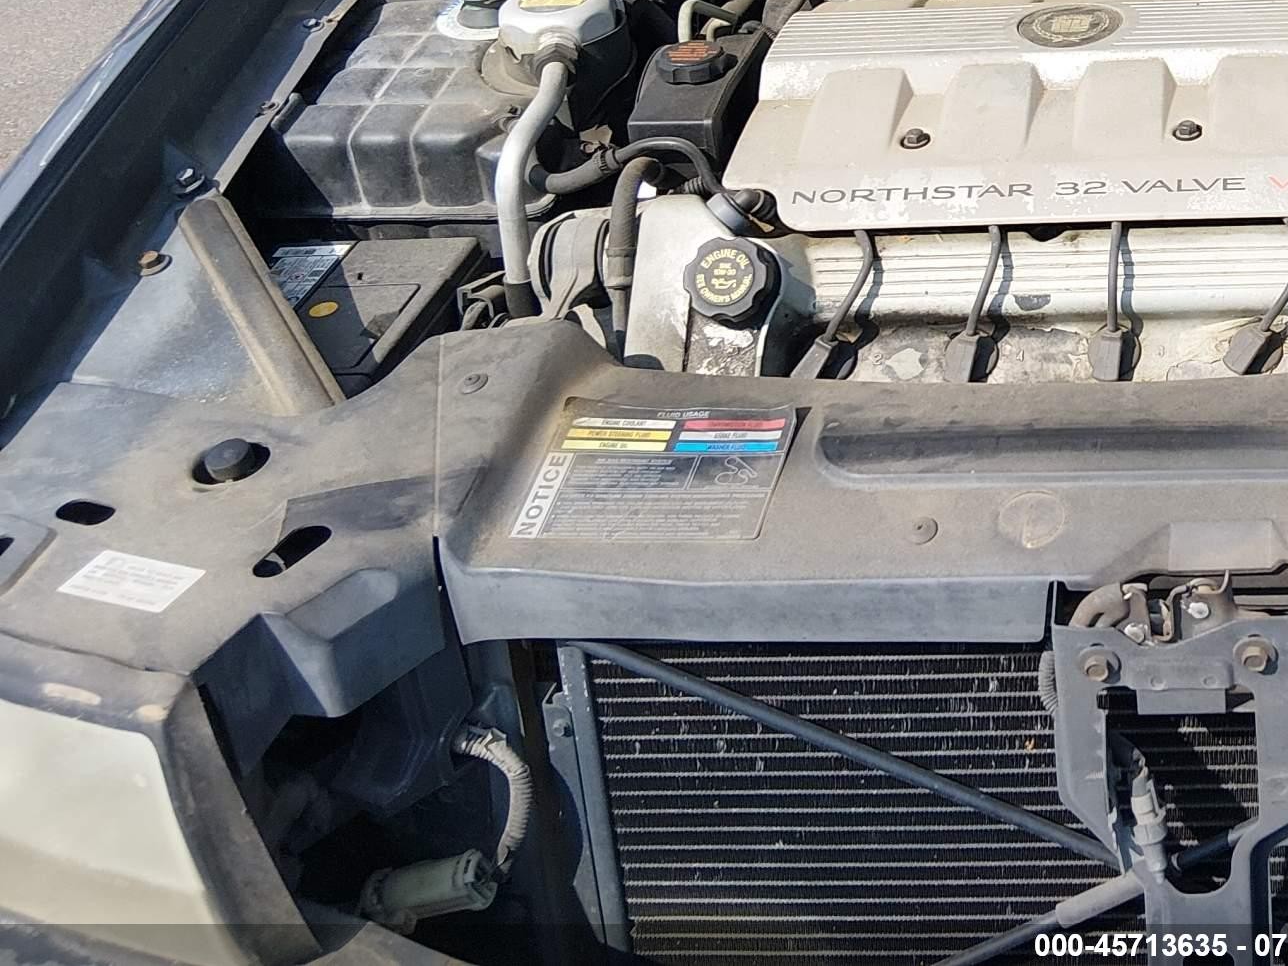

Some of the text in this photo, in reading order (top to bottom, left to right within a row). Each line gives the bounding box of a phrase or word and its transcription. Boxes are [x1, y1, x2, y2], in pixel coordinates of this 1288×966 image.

[791, 182, 1034, 205] NORTHSTAR
[1055, 180, 1108, 196] 32
[1121, 177, 1246, 194] VALVE
[700, 248, 751, 270] ENGINE OIL
[682, 410, 711, 419] USAGE
[516, 455, 568, 536] NOTICE
